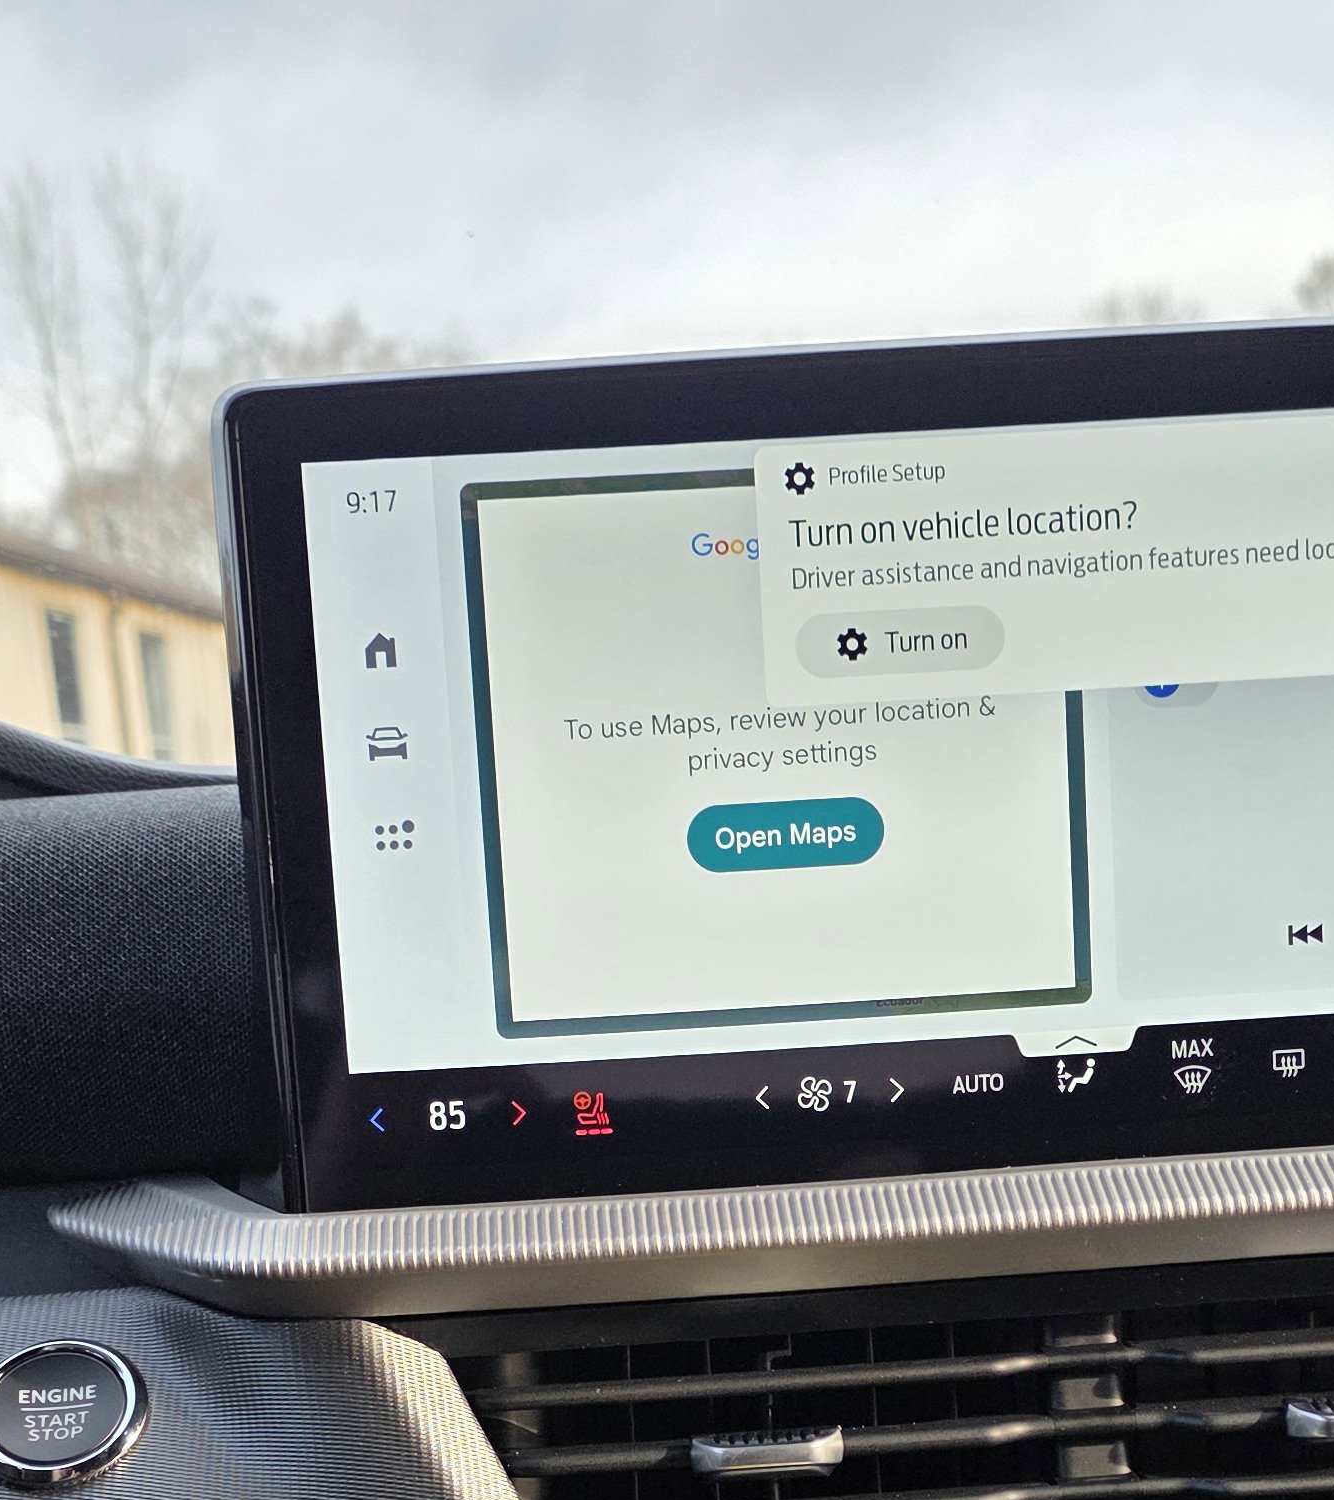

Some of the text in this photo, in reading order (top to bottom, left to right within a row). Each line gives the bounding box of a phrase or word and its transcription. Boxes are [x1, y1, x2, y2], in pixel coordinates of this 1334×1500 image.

[828, 462, 946, 486] Profile Setup
[346, 489, 396, 514] 9:17
[788, 500, 1137, 548] Turn on vehicle location?
[792, 566, 856, 590] Driver
[861, 561, 974, 586] assistance
[980, 554, 1022, 579] and
[1027, 549, 1143, 579] navigation
[1148, 546, 1240, 570] features
[1245, 538, 1299, 564] need
[884, 630, 968, 654] Turn on
[563, 695, 996, 740] To use Maps, review your location &
[688, 740, 877, 777] privacy settings
[715, 822, 857, 855] Open Maps
[1171, 1037, 1214, 1060] MAX
[843, 1080, 857, 1104] 7
[952, 1072, 1004, 1095] AUTO
[429, 1100, 466, 1131] 85
[18, 1384, 97, 1404] ENGINE
[24, 1411, 90, 1429] START
[27, 1425, 84, 1442] STOP
